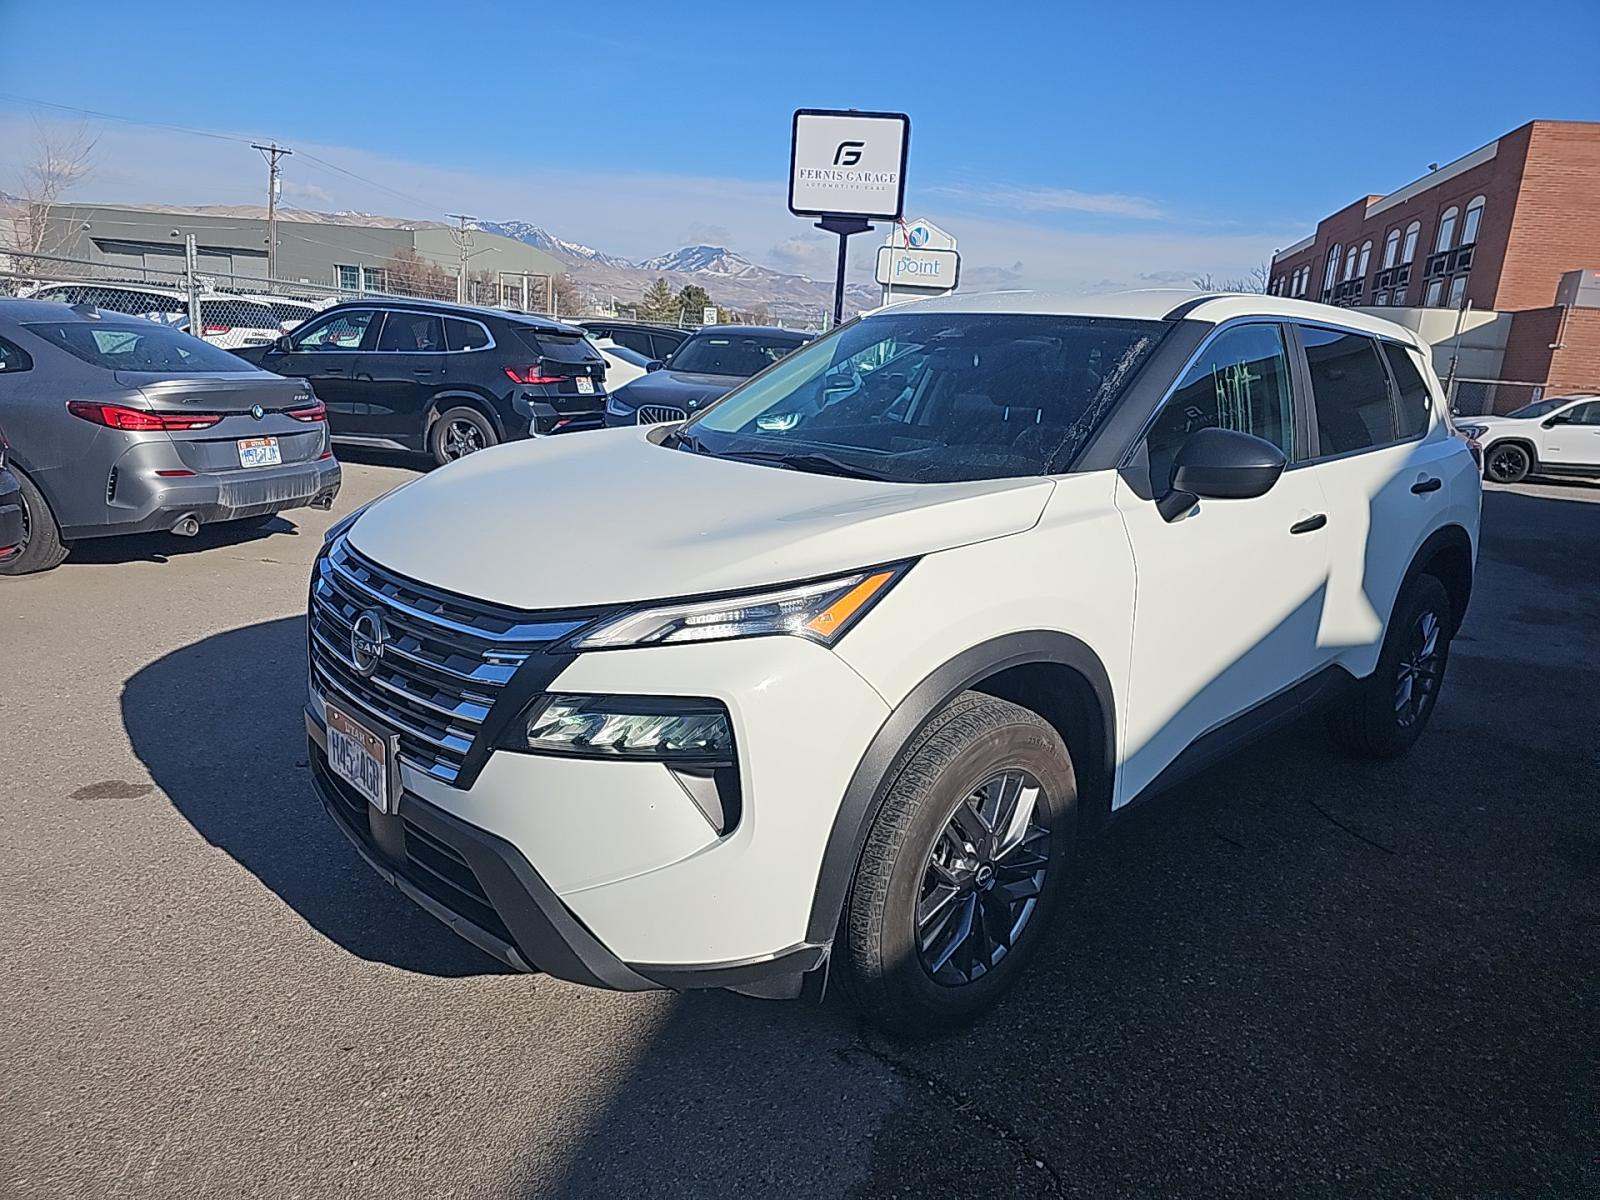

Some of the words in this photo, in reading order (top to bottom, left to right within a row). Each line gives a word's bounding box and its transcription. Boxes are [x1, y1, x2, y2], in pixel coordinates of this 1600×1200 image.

[800, 168, 843, 180] FERNIS
[846, 171, 897, 184] GARAGE
[896, 258, 940, 276] point
